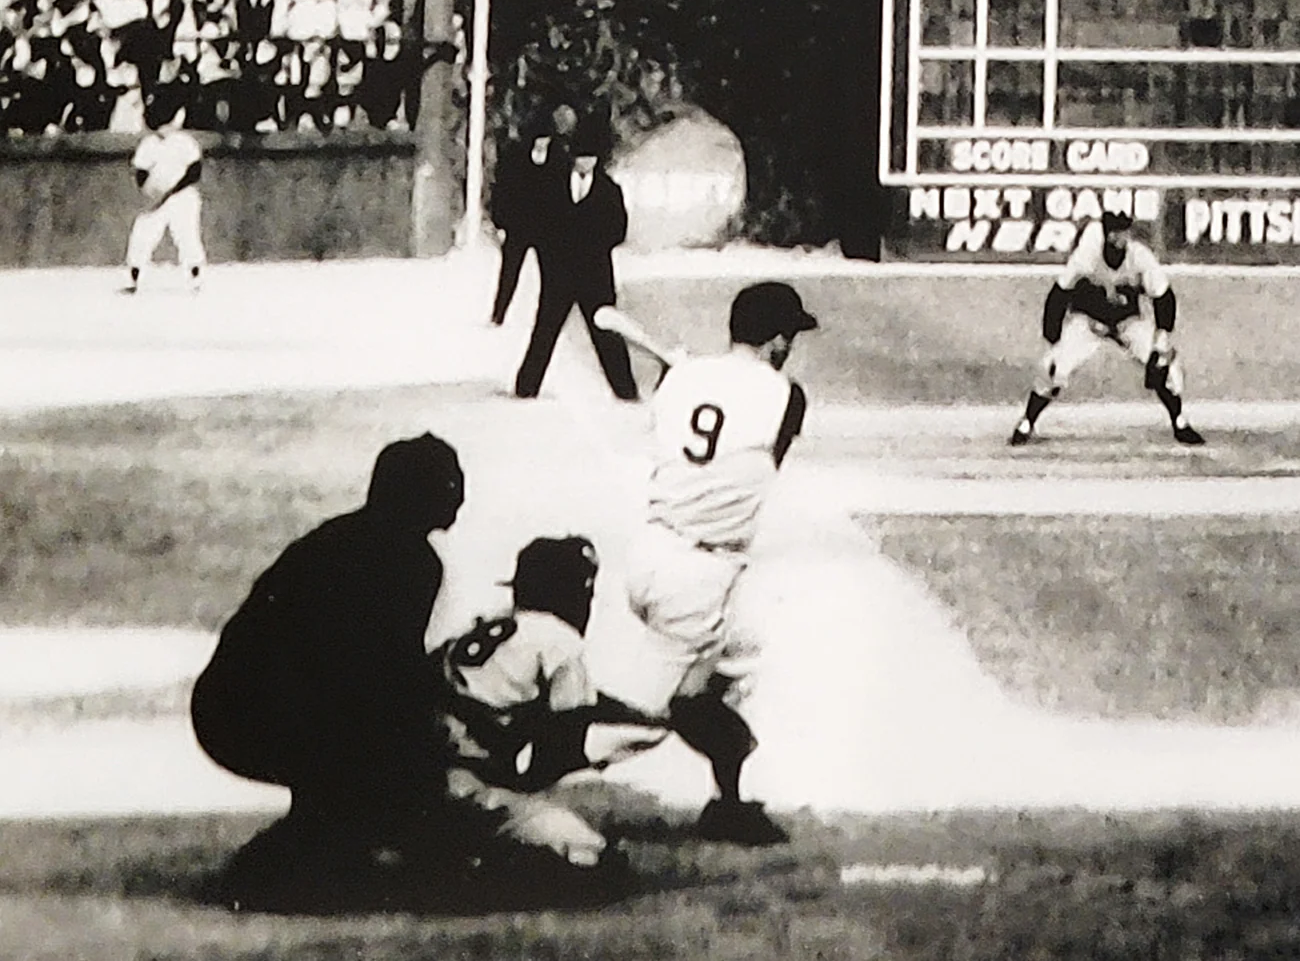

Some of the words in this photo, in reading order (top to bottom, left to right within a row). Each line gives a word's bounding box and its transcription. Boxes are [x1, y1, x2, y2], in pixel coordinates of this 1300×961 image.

[951, 140, 1049, 172] SCORE
[1066, 140, 1150, 173] CARD
[910, 188, 1032, 219] NEXT
[1045, 188, 1160, 221] GAME
[682, 402, 726, 466] 9
